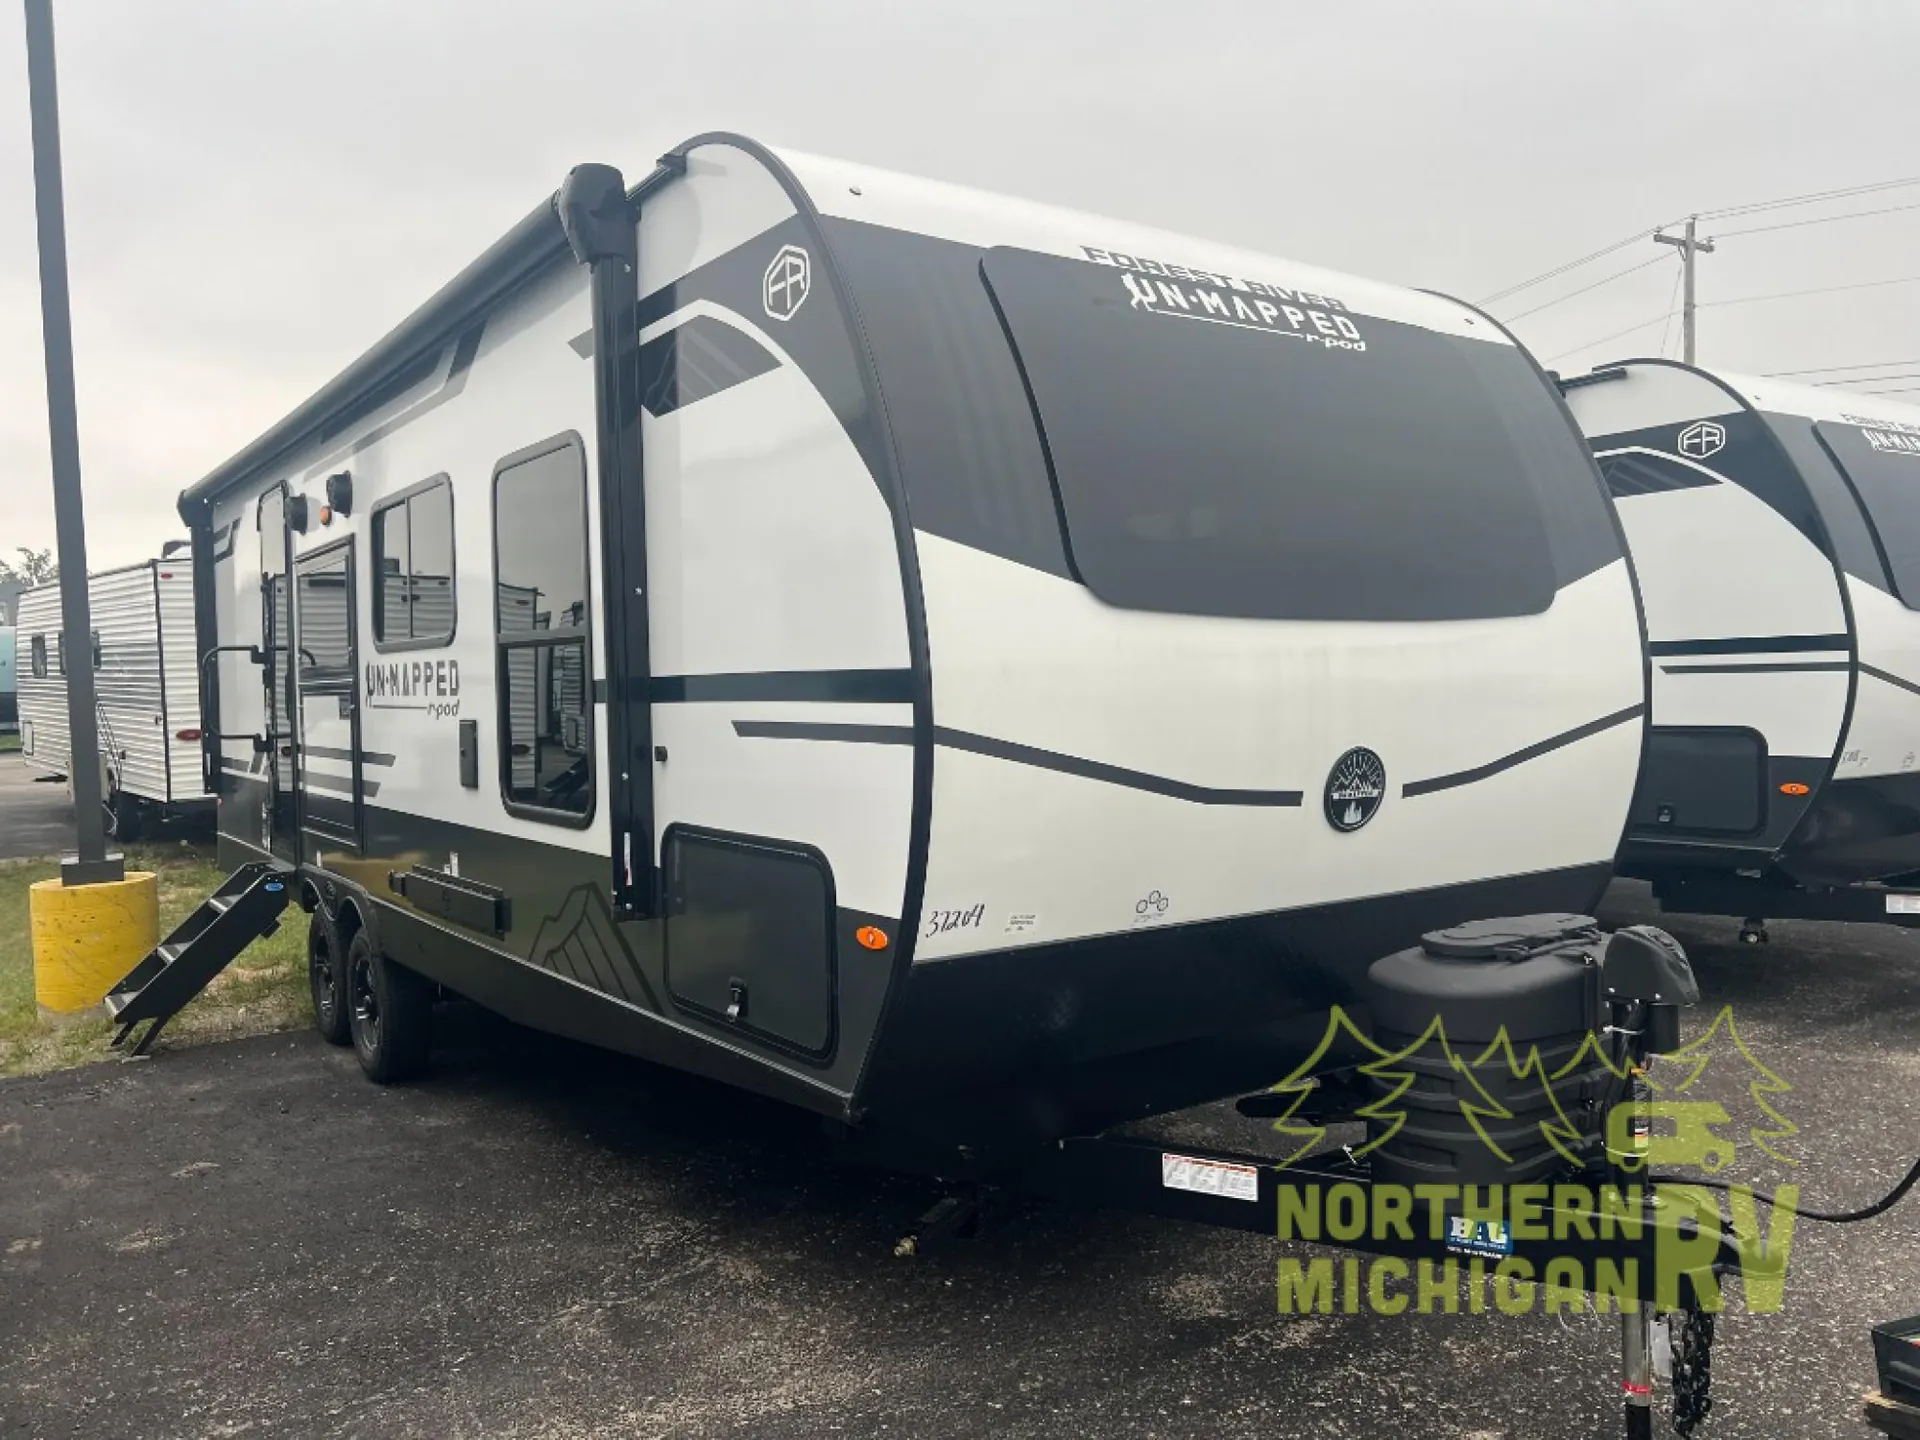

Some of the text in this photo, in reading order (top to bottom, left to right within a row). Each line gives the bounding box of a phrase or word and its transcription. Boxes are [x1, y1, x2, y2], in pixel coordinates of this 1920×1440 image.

[1080, 245, 1349, 312] FOREST RIVER
[1306, 332, 1367, 352] r-pod
